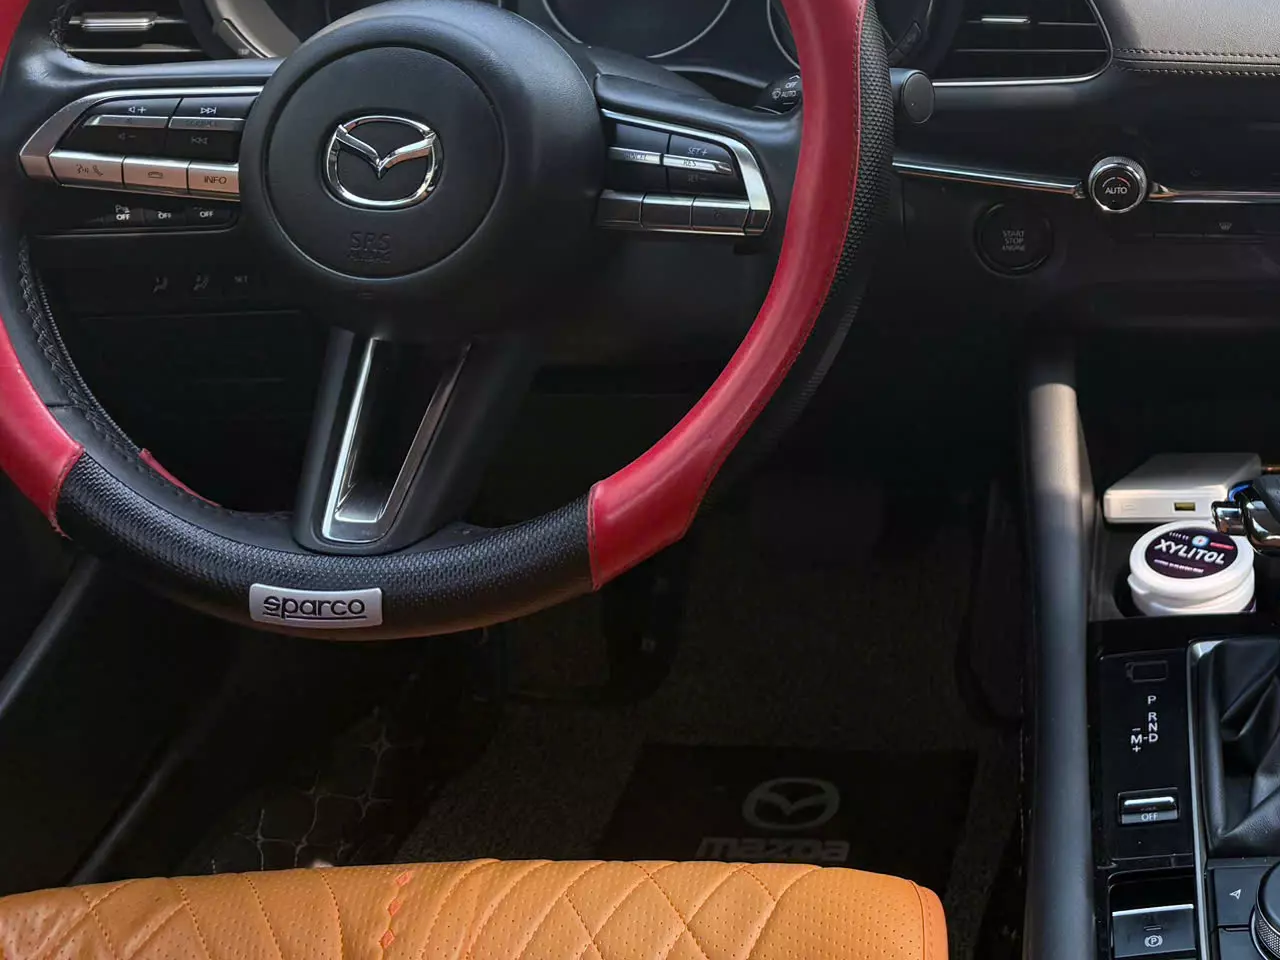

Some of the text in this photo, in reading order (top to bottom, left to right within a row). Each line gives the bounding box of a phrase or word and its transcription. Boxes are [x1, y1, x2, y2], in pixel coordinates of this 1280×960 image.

[781, 90, 797, 98] AUTO
[204, 175, 228, 185] INFO
[1104, 186, 1128, 195] AUTO
[116, 213, 131, 221] OFF
[1153, 538, 1226, 565] XYLITOL
[263, 595, 365, 622] sparco
[1147, 695, 1157, 705] P
[1147, 711, 1158, 722] R
[1147, 722, 1158, 733] N
[1140, 811, 1159, 822] OFF
